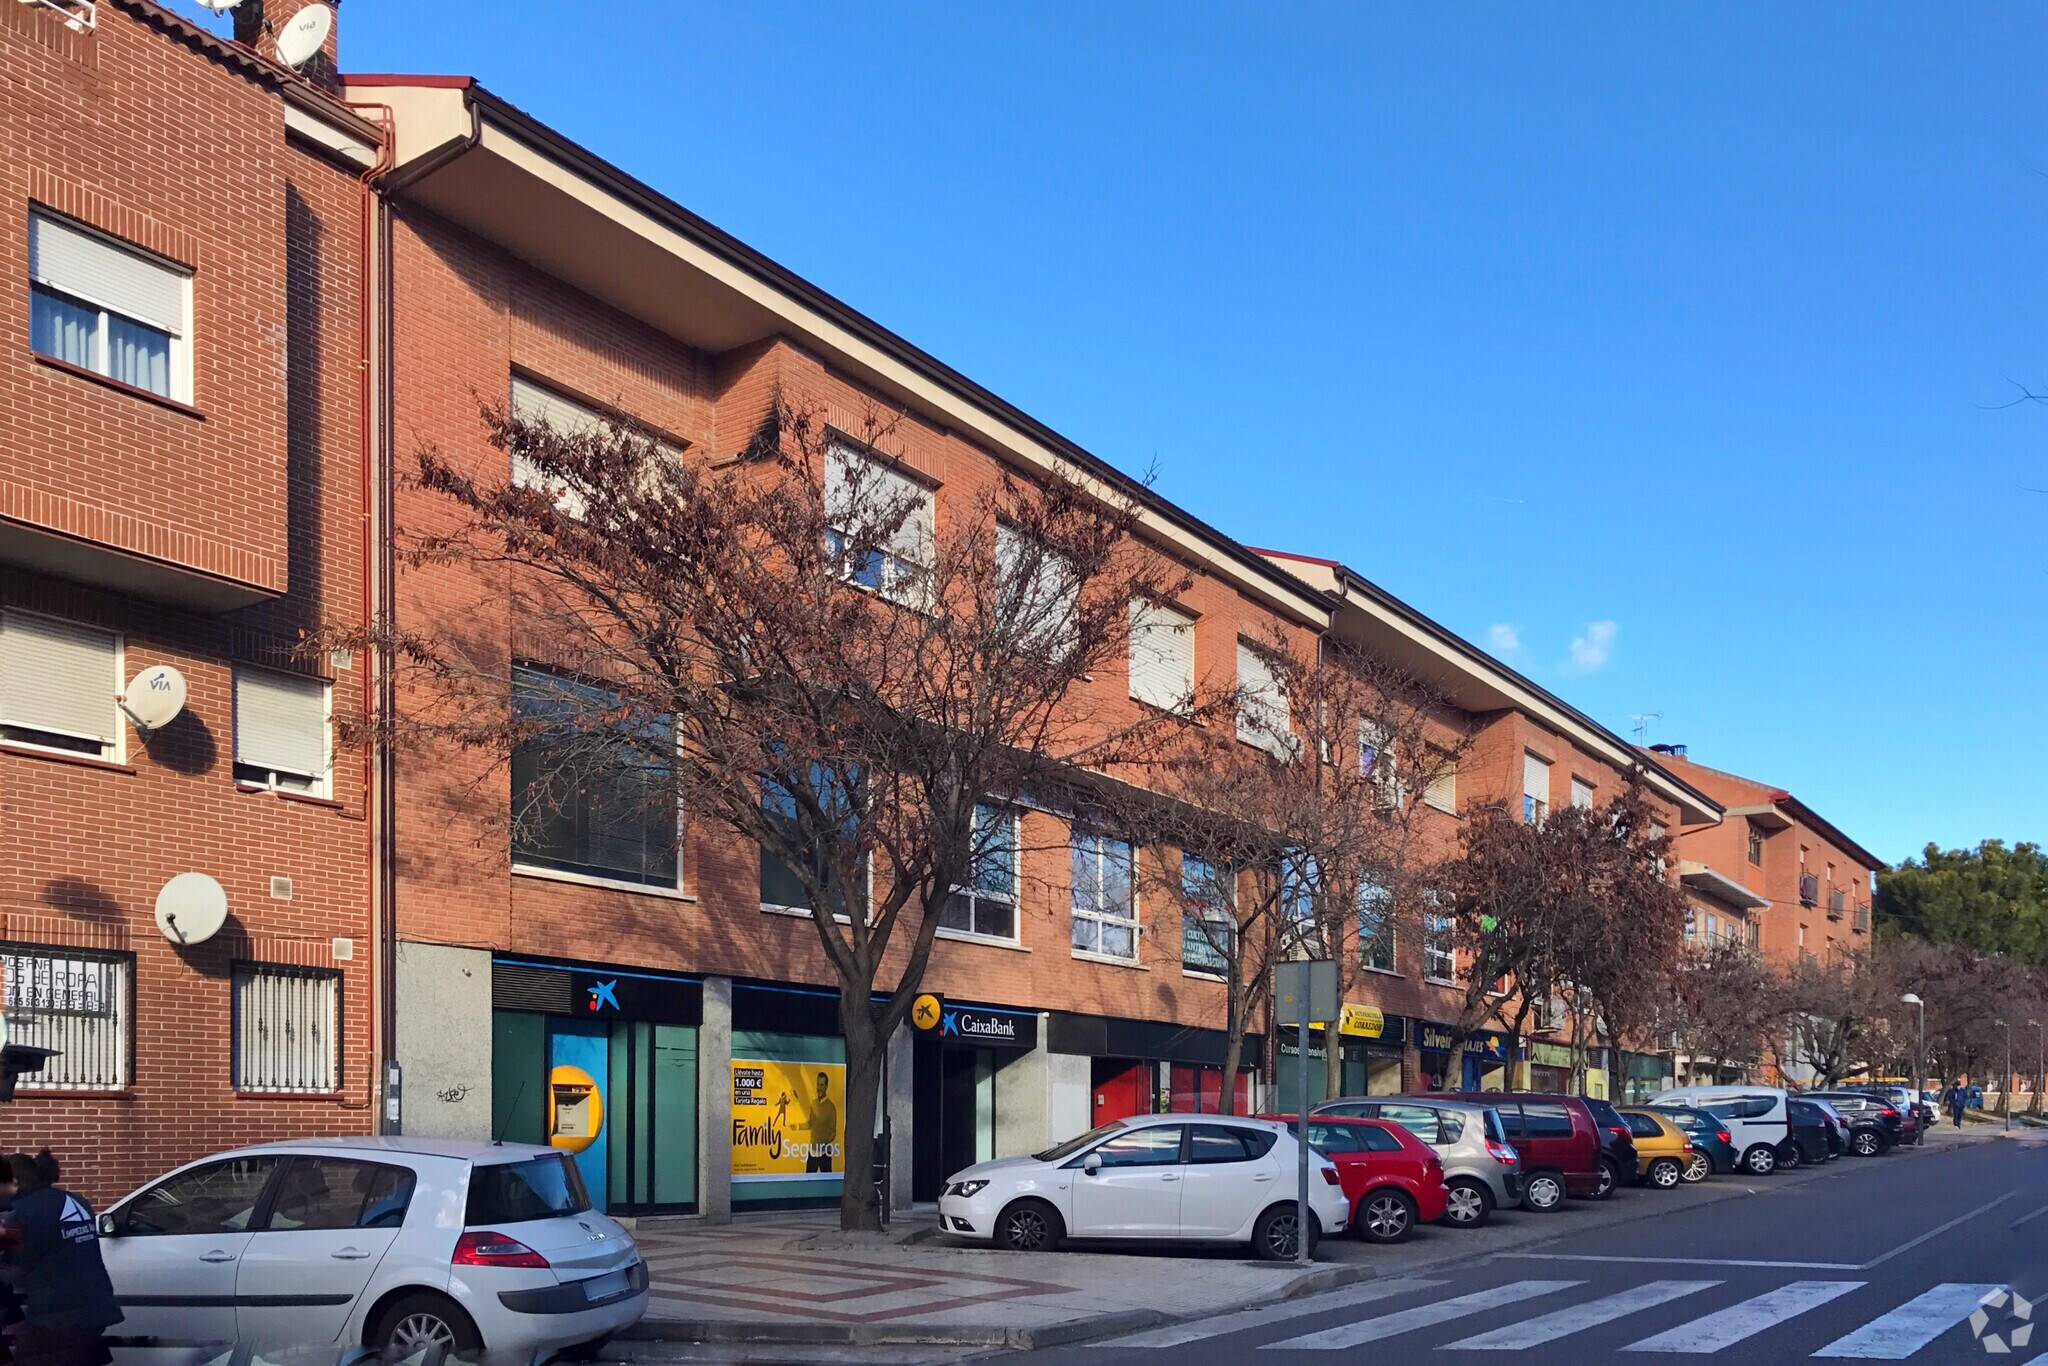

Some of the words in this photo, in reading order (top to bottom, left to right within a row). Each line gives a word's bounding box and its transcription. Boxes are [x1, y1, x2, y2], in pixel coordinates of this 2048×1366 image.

[55, 971, 98, 988] ROPA
[961, 1014, 1015, 1036] CaixaBank
[1423, 1027, 1453, 1049] Silveir
[1464, 1039, 1484, 1053] IAJES
[735, 1078, 755, 1087] 1.000
[756, 1079, 762, 1088] €
[735, 1097, 750, 1105] Tarjeta
[732, 1116, 782, 1160] Family
[782, 1138, 840, 1163] Seguros
